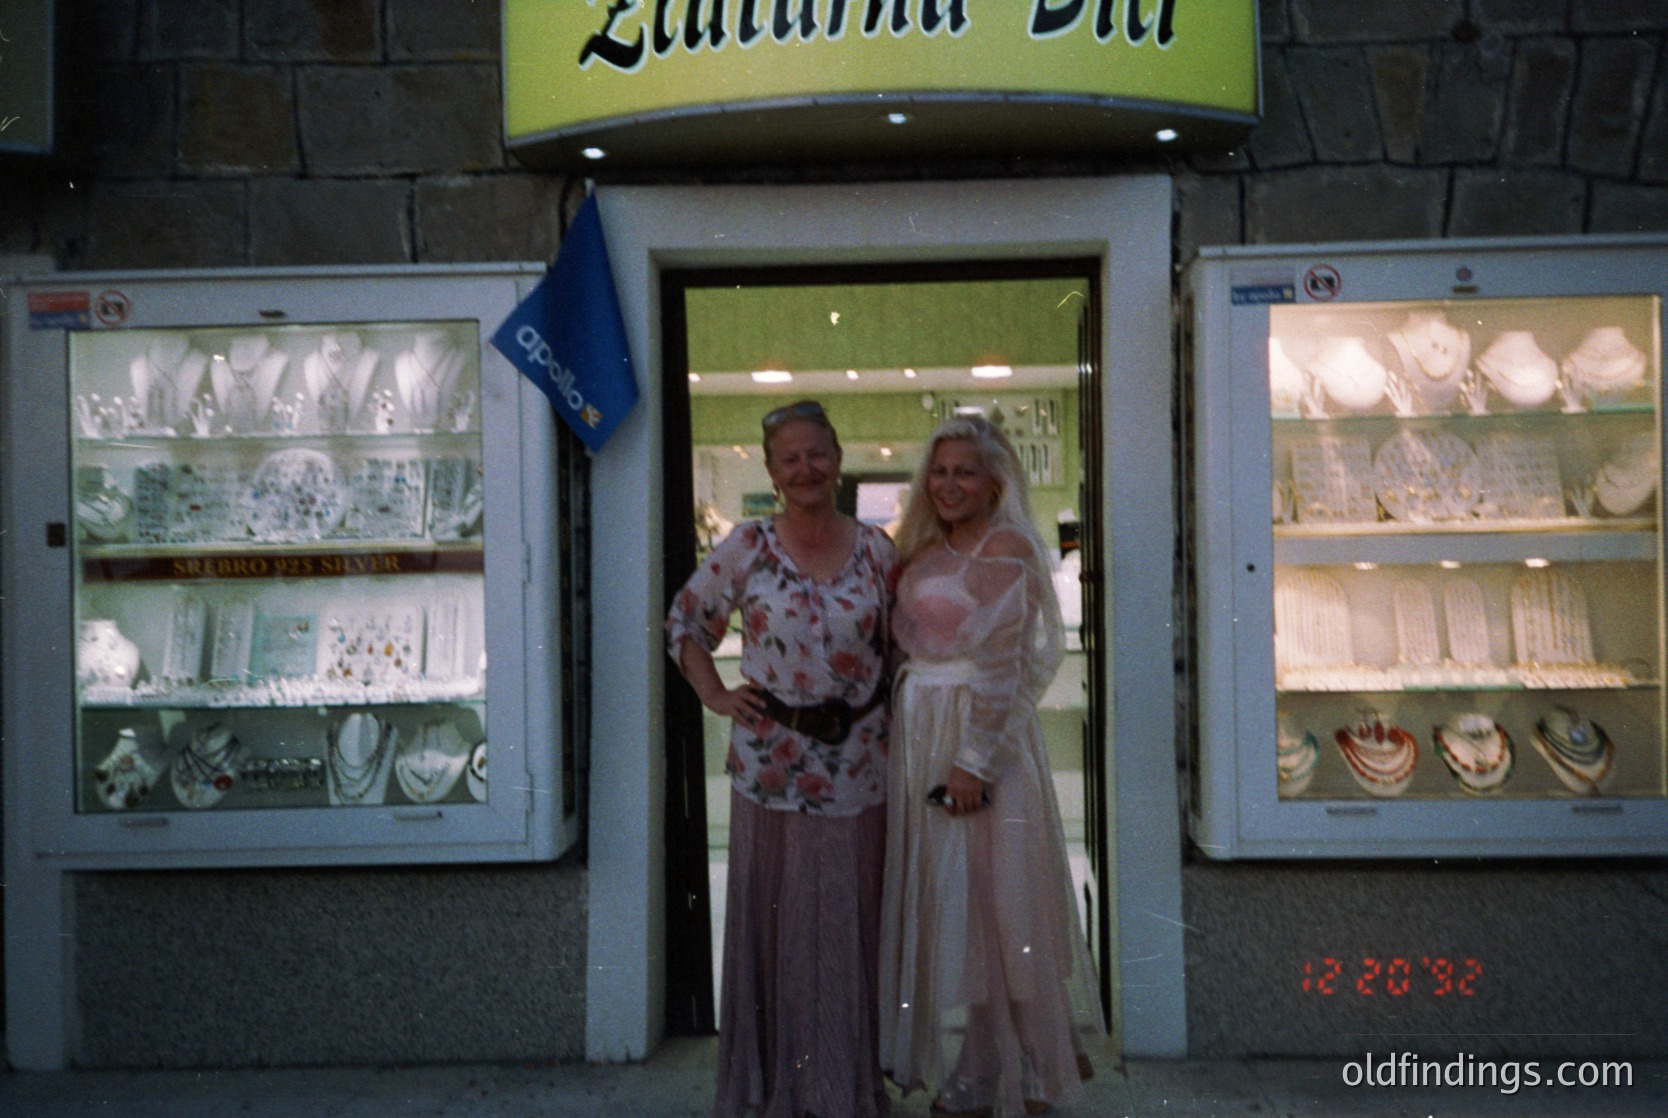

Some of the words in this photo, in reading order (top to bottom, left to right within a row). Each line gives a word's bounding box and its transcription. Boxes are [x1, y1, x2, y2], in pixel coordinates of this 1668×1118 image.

[516, 325, 583, 411] apollo
[173, 558, 268, 577] SREBRO
[274, 558, 312, 576] 925
[320, 555, 399, 574] SILVER
